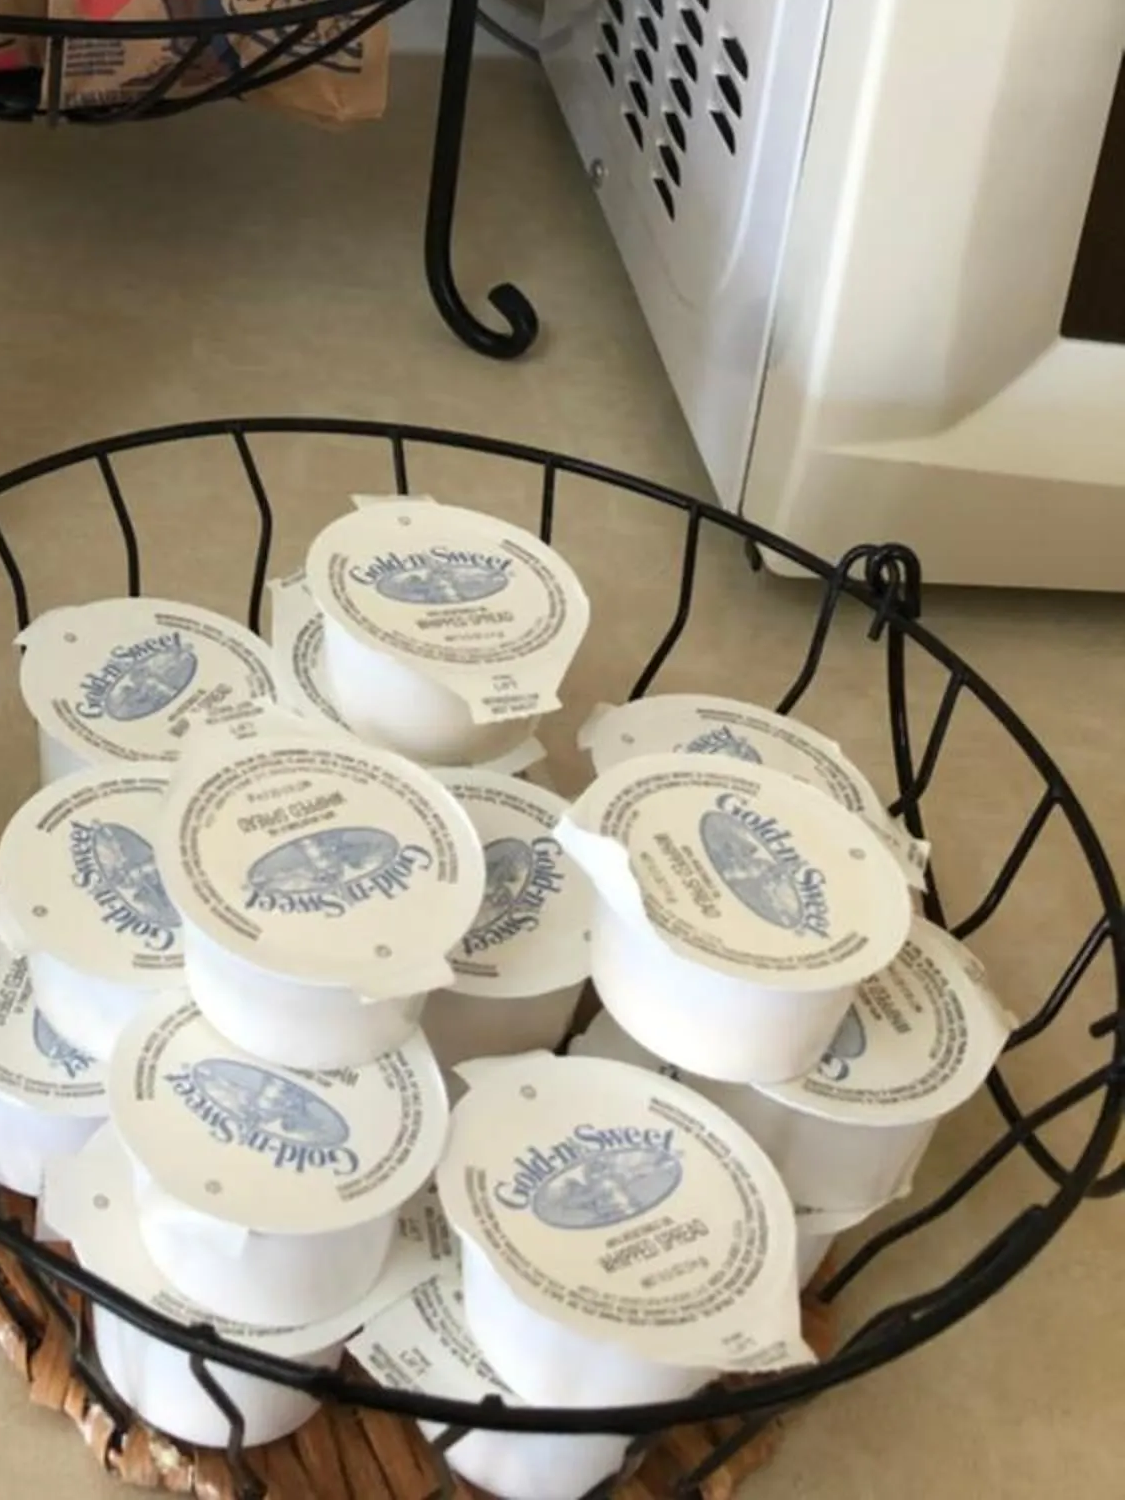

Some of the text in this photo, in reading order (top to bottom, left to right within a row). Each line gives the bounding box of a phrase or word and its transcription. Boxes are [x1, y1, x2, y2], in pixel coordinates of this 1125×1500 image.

[429, 545, 513, 575] Sweet
[111, 632, 184, 664] Sweet
[69, 820, 100, 889] Sweet
[243, 889, 347, 919] Sweet
[795, 866, 831, 940] Sweet
[461, 911, 540, 955] Sweet
[162, 1070, 238, 1145] Sweet
[574, 1123, 675, 1151] Sweet
